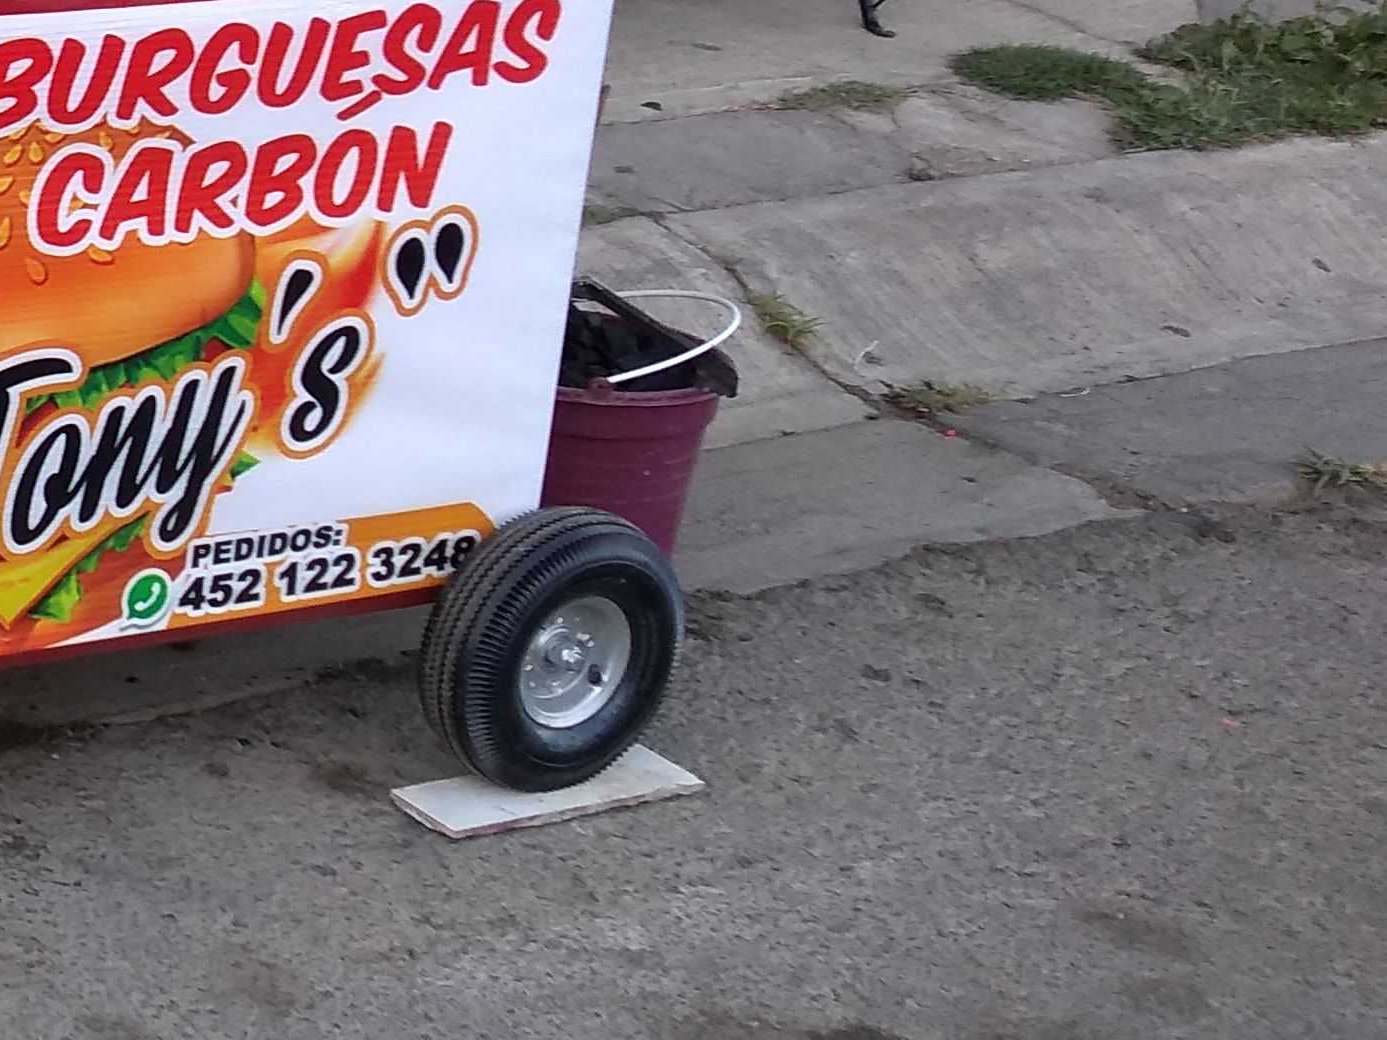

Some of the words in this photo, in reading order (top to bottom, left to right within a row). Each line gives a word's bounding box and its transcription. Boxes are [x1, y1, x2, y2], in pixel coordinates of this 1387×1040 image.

[36, 90, 453, 247] CARBÓN
[179, 568, 261, 611] 452
[279, 553, 356, 597] 122
[370, 535, 477, 582] 3248
[192, 525, 343, 568] PEDIDOS:
